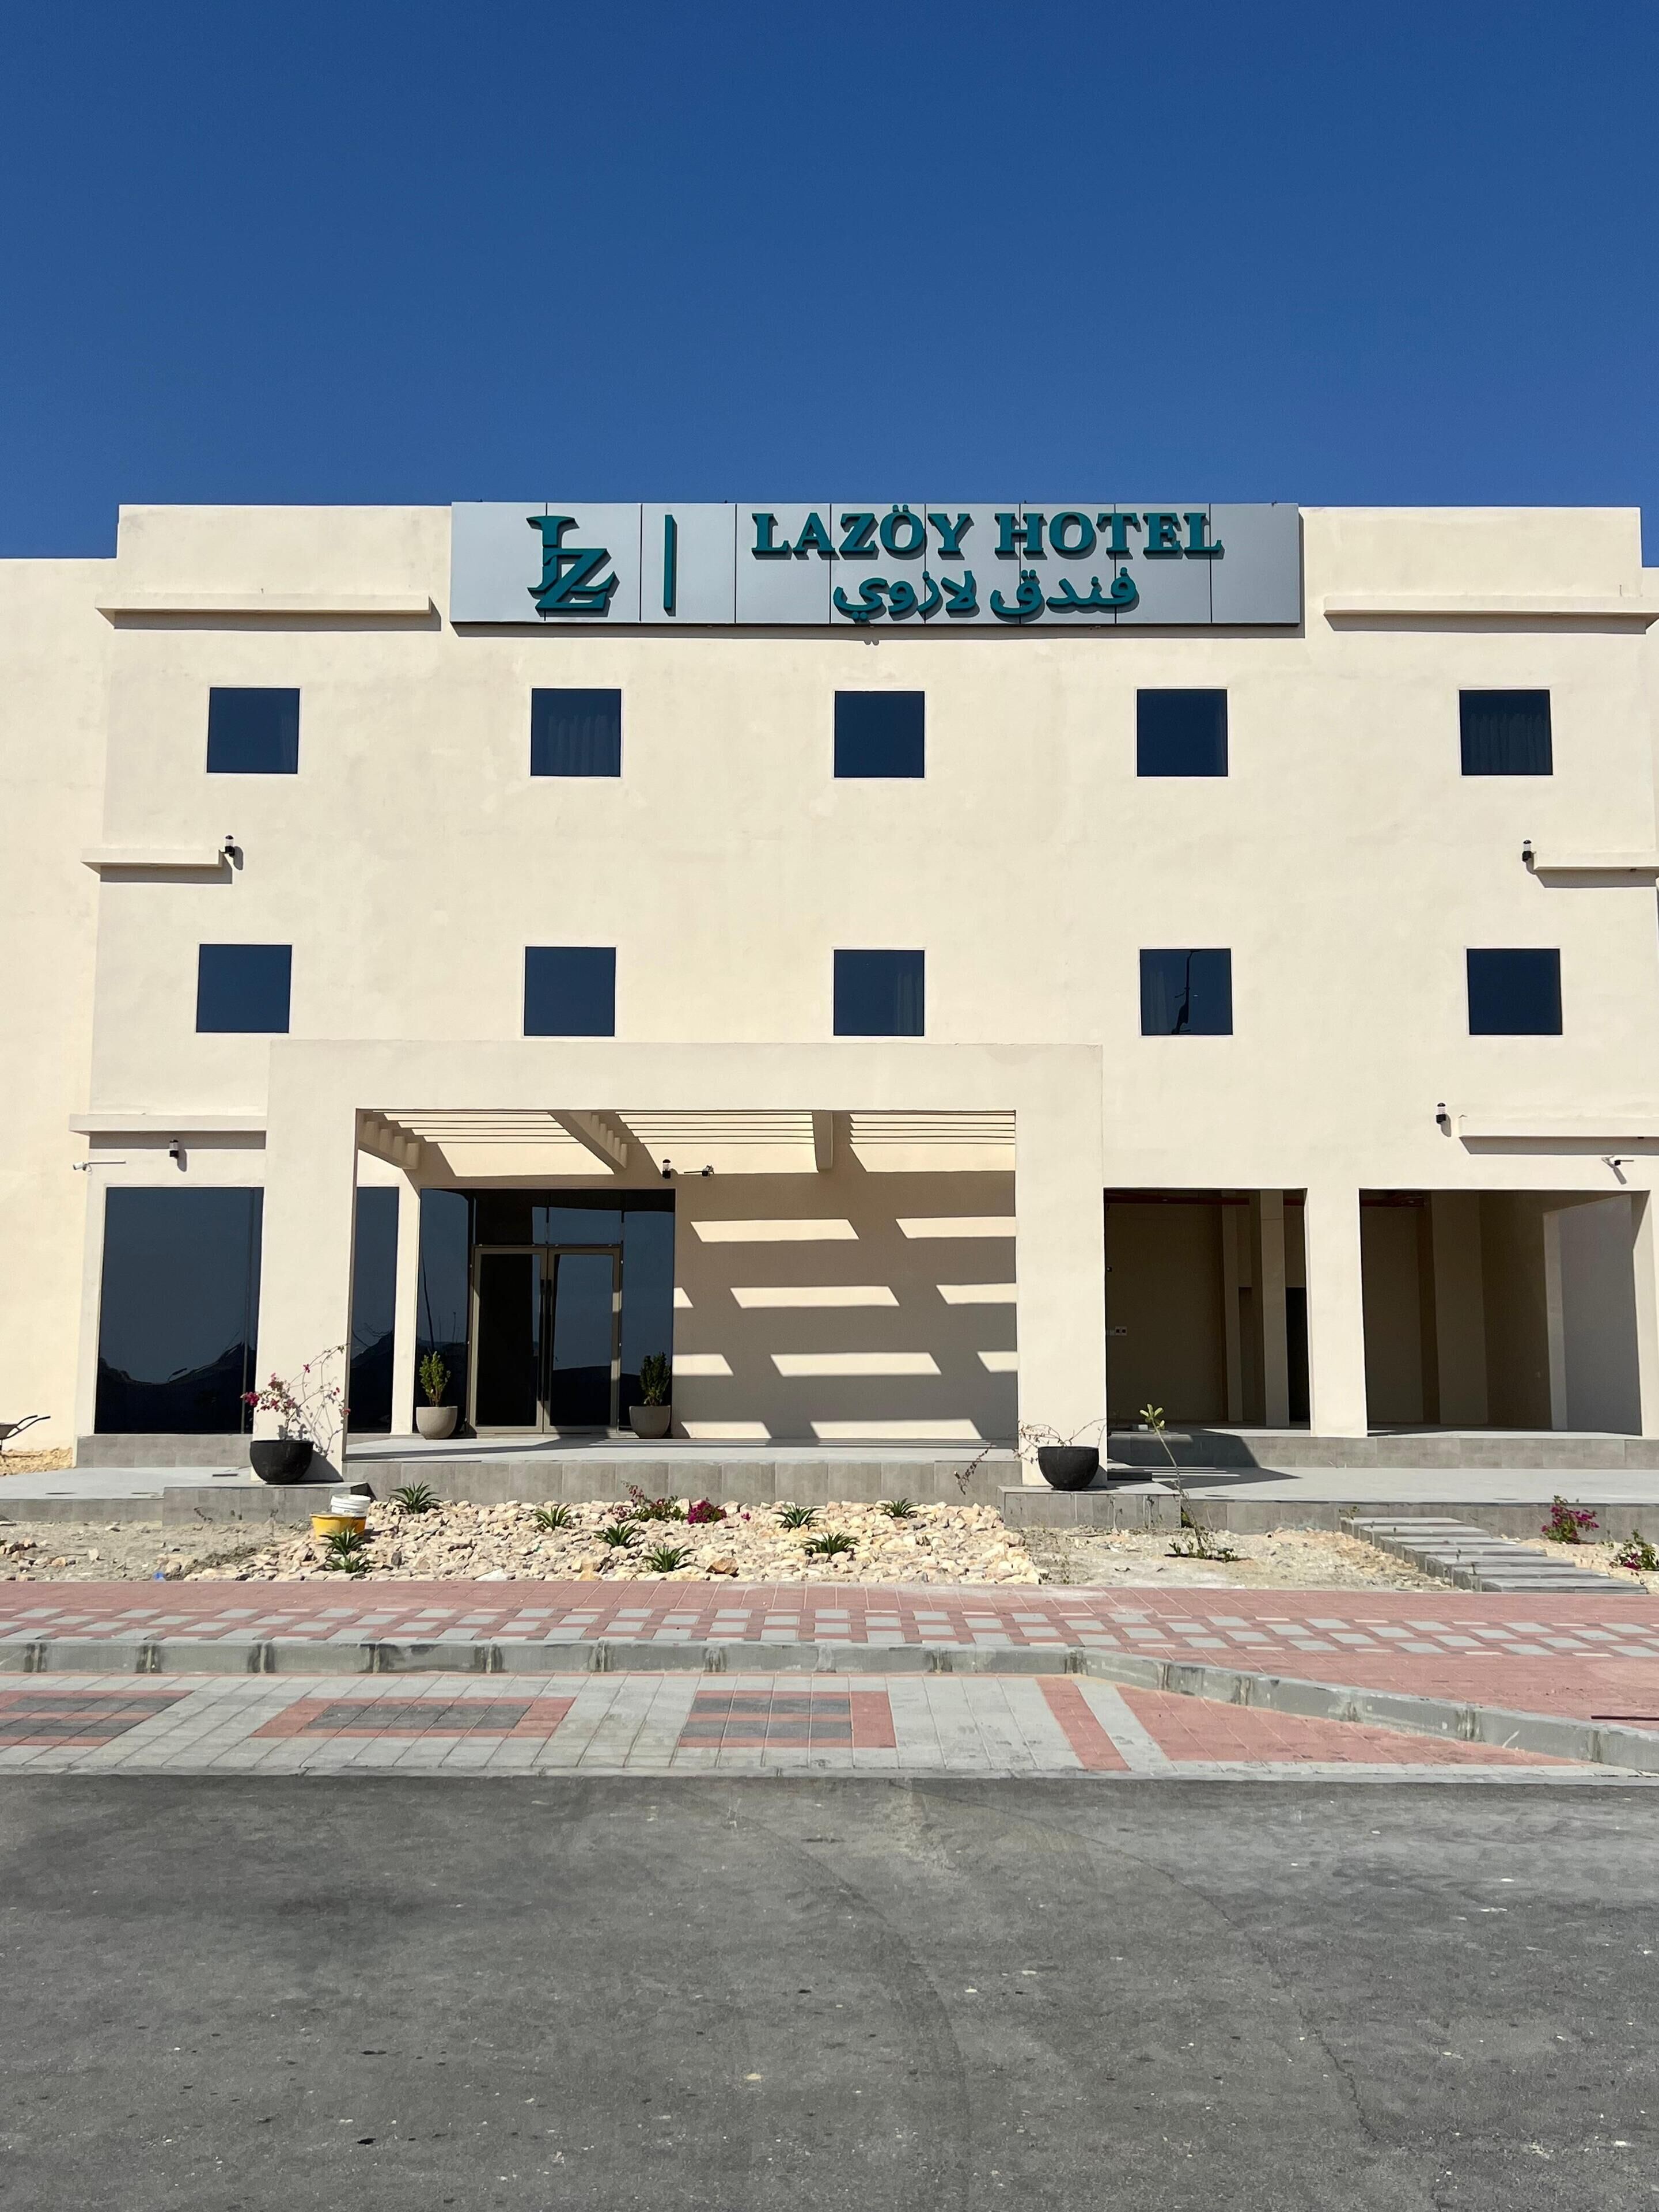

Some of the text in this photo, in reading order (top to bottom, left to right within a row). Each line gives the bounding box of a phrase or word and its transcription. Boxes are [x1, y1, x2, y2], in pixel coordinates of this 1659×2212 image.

[751, 504, 1222, 554] LAZÖY HOTEL
[833, 567, 1138, 621] فندق لازوي
